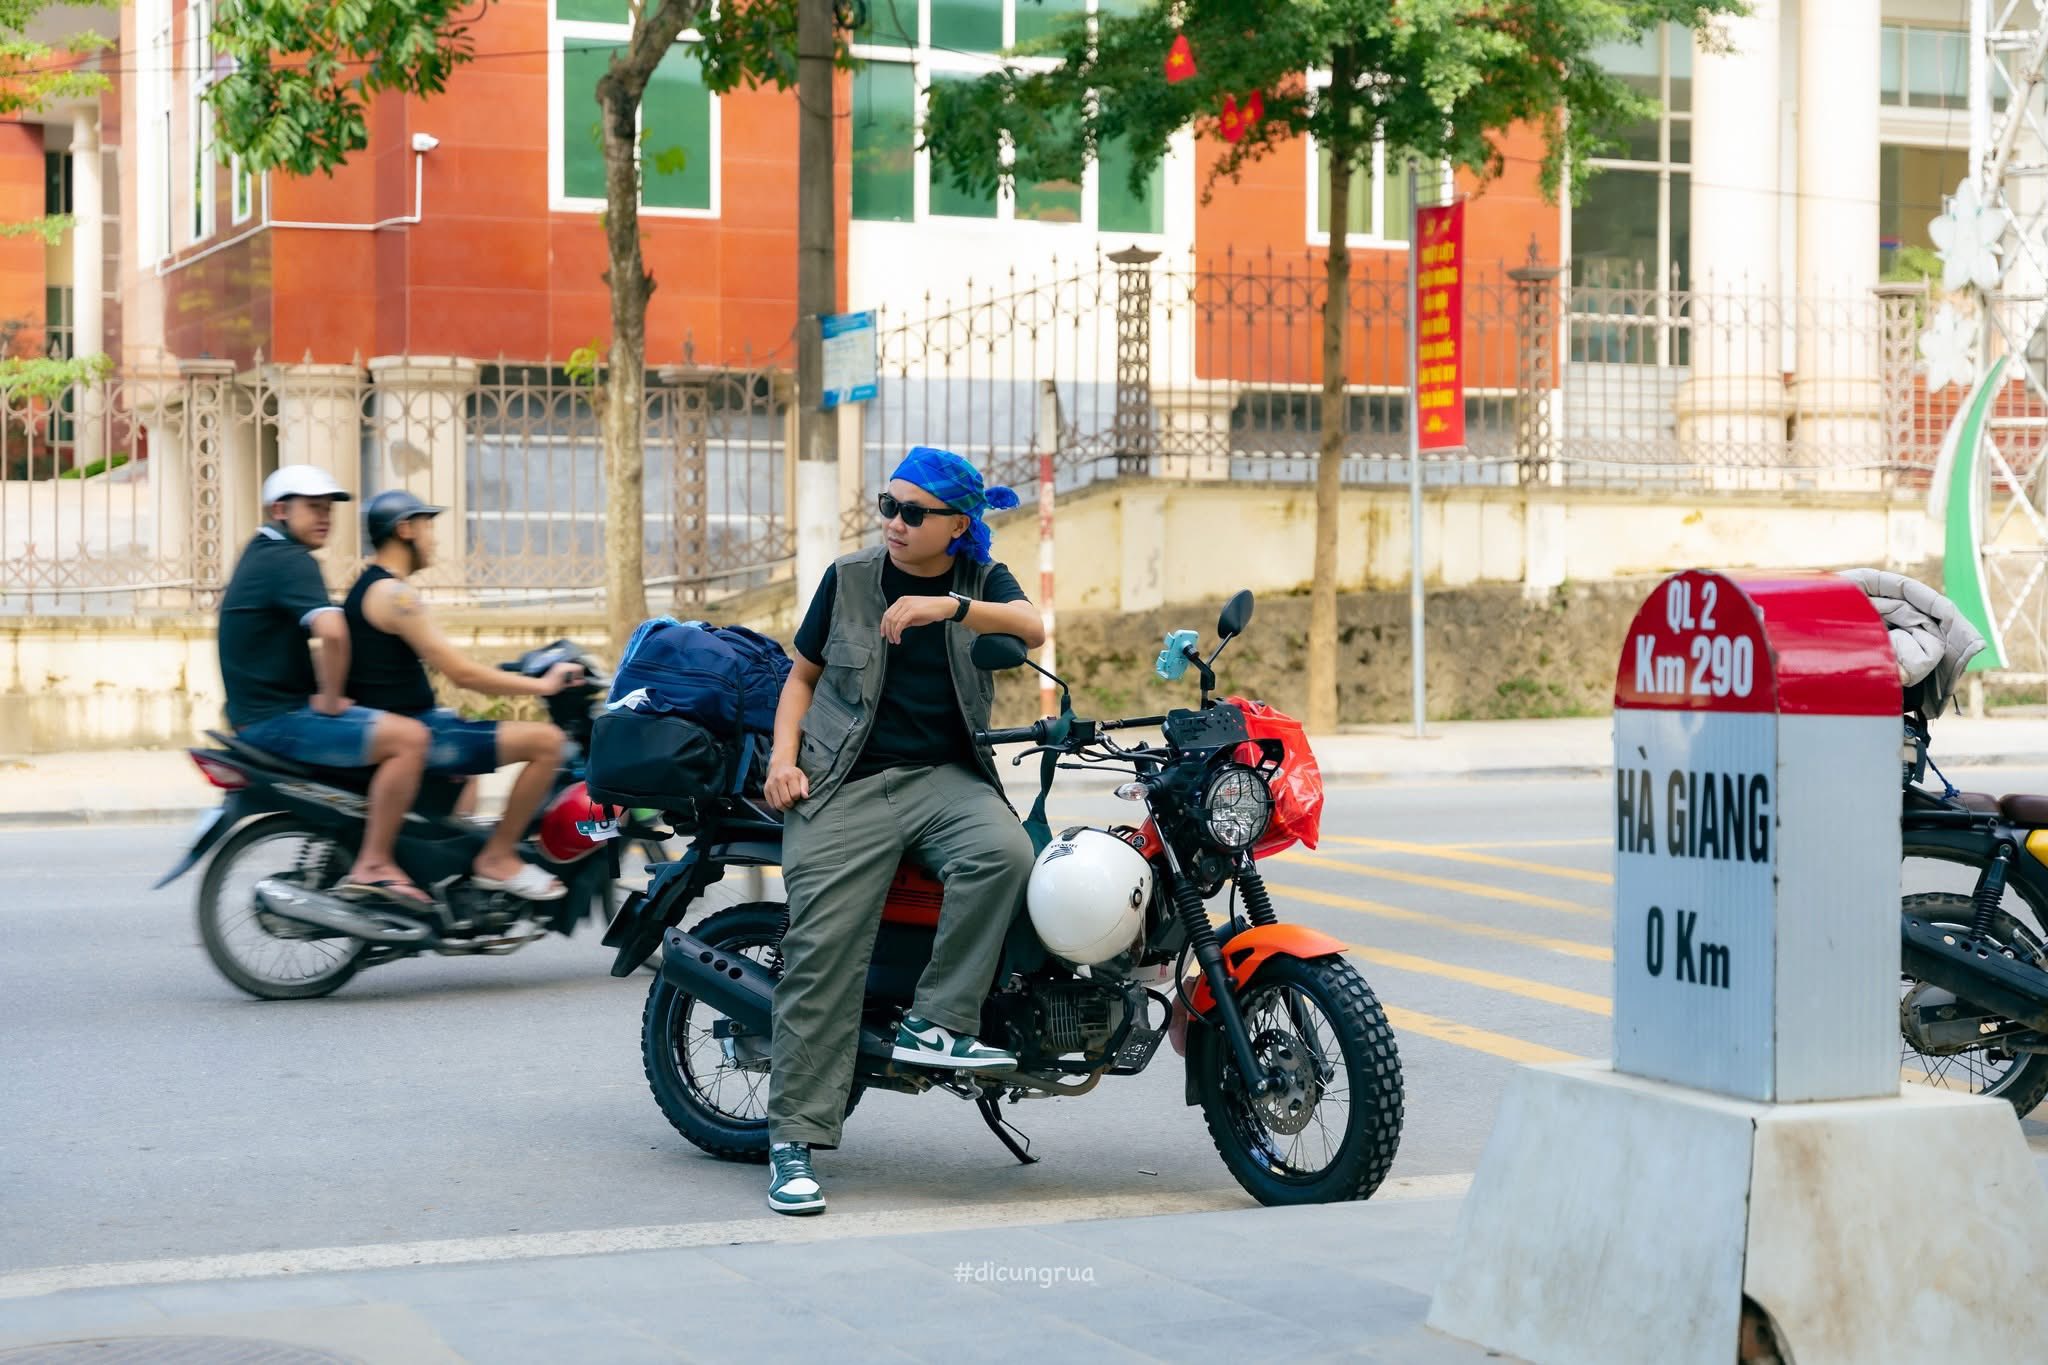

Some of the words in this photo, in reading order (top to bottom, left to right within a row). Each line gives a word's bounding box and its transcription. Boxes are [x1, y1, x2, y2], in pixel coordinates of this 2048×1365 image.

[1667, 579, 1695, 634] QL
[1701, 580, 1718, 630] 2
[1635, 634, 1686, 694] Km
[1690, 635, 1753, 697] 290
[1617, 746, 1656, 855] HÀ
[1667, 769, 1769, 863] GIANG
[1646, 905, 1664, 977] 0
[1676, 909, 1730, 989] Km
